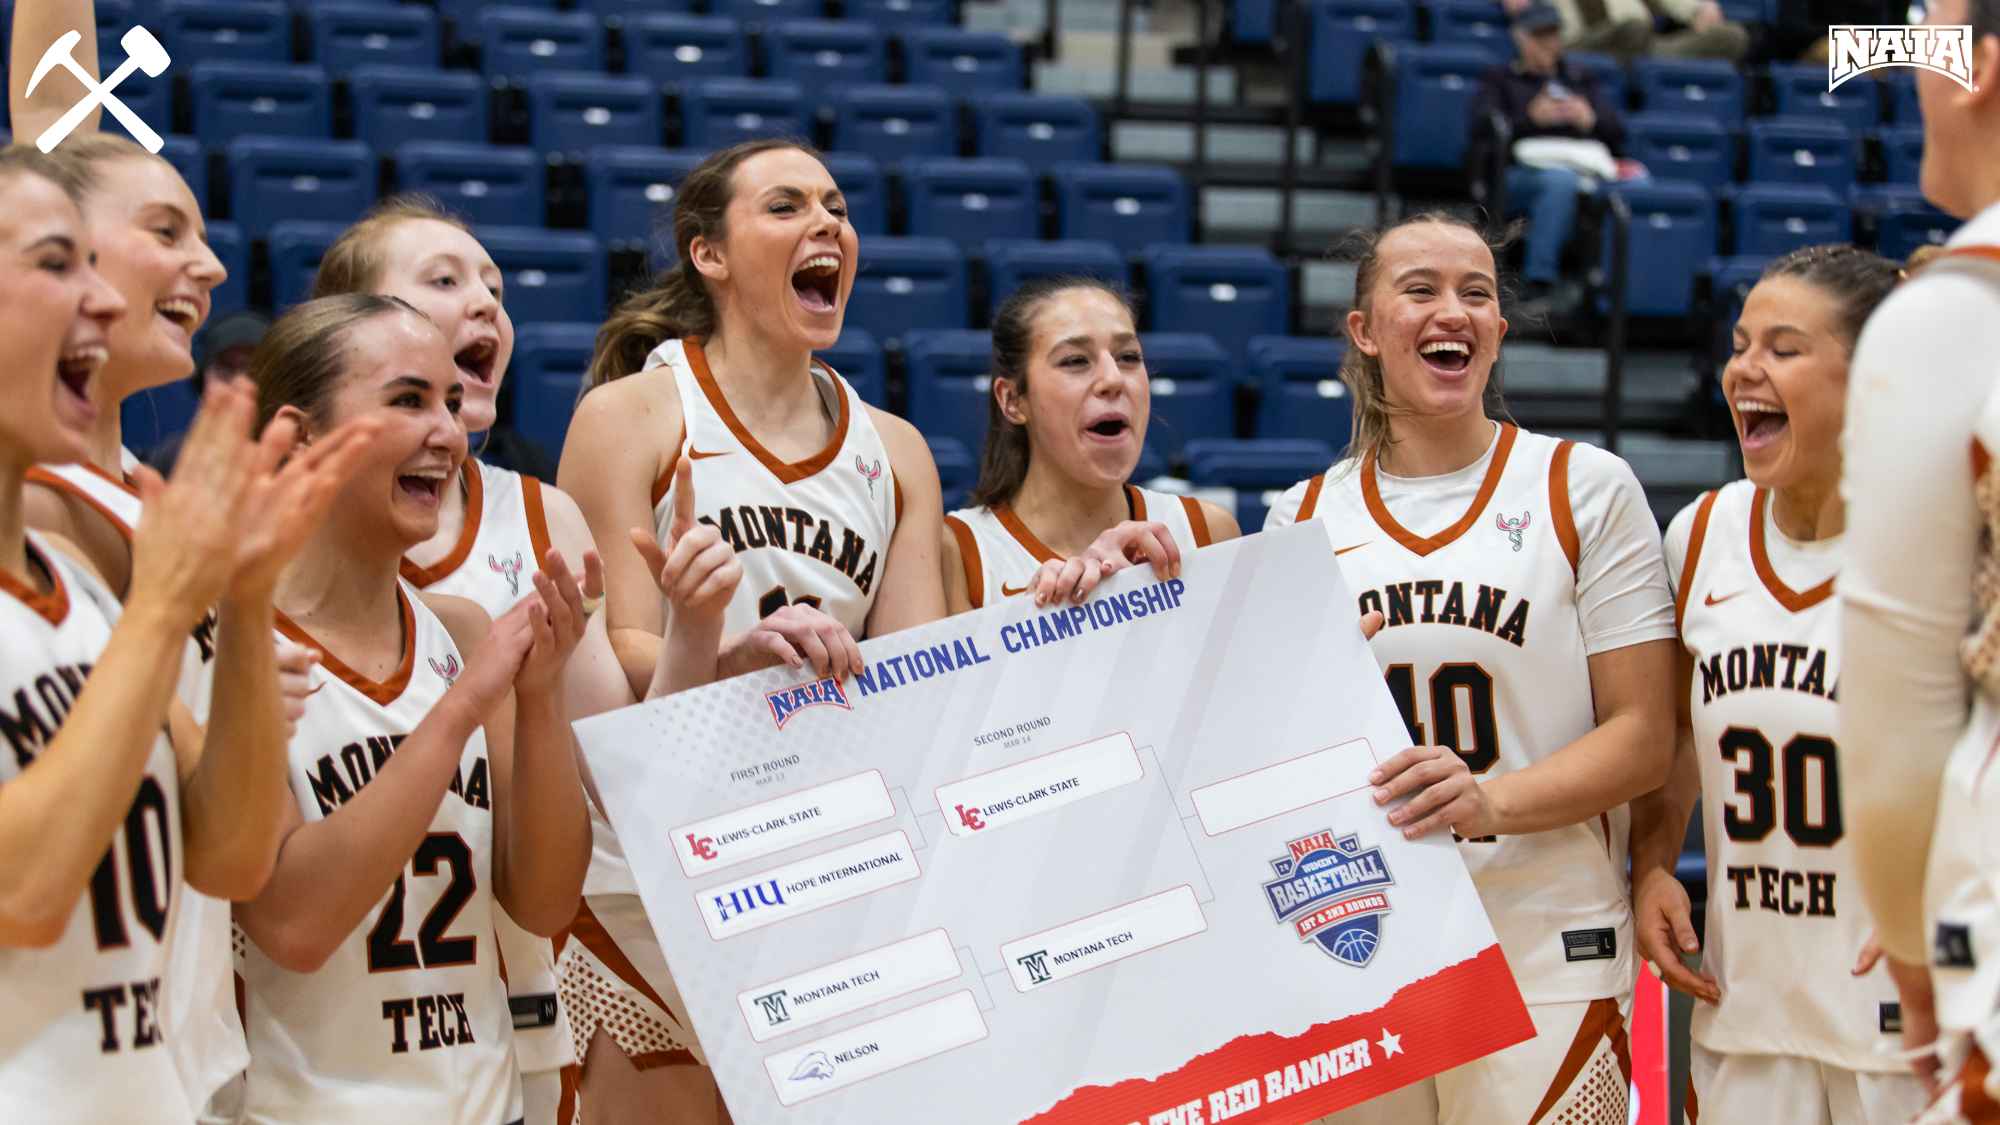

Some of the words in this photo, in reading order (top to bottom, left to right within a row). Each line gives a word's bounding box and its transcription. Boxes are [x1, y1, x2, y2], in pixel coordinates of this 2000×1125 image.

[1358, 580, 1530, 648] ONTANA
[854, 637, 990, 698] NATIONAL
[1000, 578, 1186, 655] CHAMPIONSHIP
[1700, 643, 1841, 706] MONTA
[768, 678, 846, 723] NAIA
[973, 727, 1015, 747] SECOND
[1016, 716, 1051, 735] ROUND
[1003, 738, 1021, 750] MAR
[1023, 735, 1032, 744] 14
[730, 765, 760, 782] FIRST
[762, 754, 800, 773] ROUND
[755, 775, 773, 787] MAR
[776, 772, 785, 781] 13
[1718, 724, 1846, 848] 30
[982, 787, 1049, 817] LEWIS-CLARK
[1049, 777, 1080, 795] STATE
[716, 817, 787, 846] LEWIS-CLARK
[788, 807, 822, 825] STATE
[1289, 832, 1337, 863] NAIA
[1301, 854, 1338, 874] WOMEN'S
[711, 878, 787, 924] HIU
[786, 877, 817, 895] HOPE
[818, 852, 903, 884] INTERNATIONAL
[1270, 854, 1386, 914] BASKETBALL
[1726, 865, 1837, 917] TECH
[1300, 916, 1317, 932] 1ST
[1317, 913, 1327, 923] &
[1325, 905, 1345, 920] 2ND
[1345, 896, 1385, 913] ROUNDS
[1053, 941, 1106, 966] MONTANA
[1105, 931, 1134, 949] TECH
[793, 980, 850, 1006] MONTANA
[849, 970, 881, 988] TECH
[382, 992, 476, 1054] TECH
[834, 1042, 879, 1065] NELSON
[1148, 1098, 1205, 1125] THE
[1208, 1078, 1261, 1125] RED
[1264, 1038, 1373, 1103] BANNER
